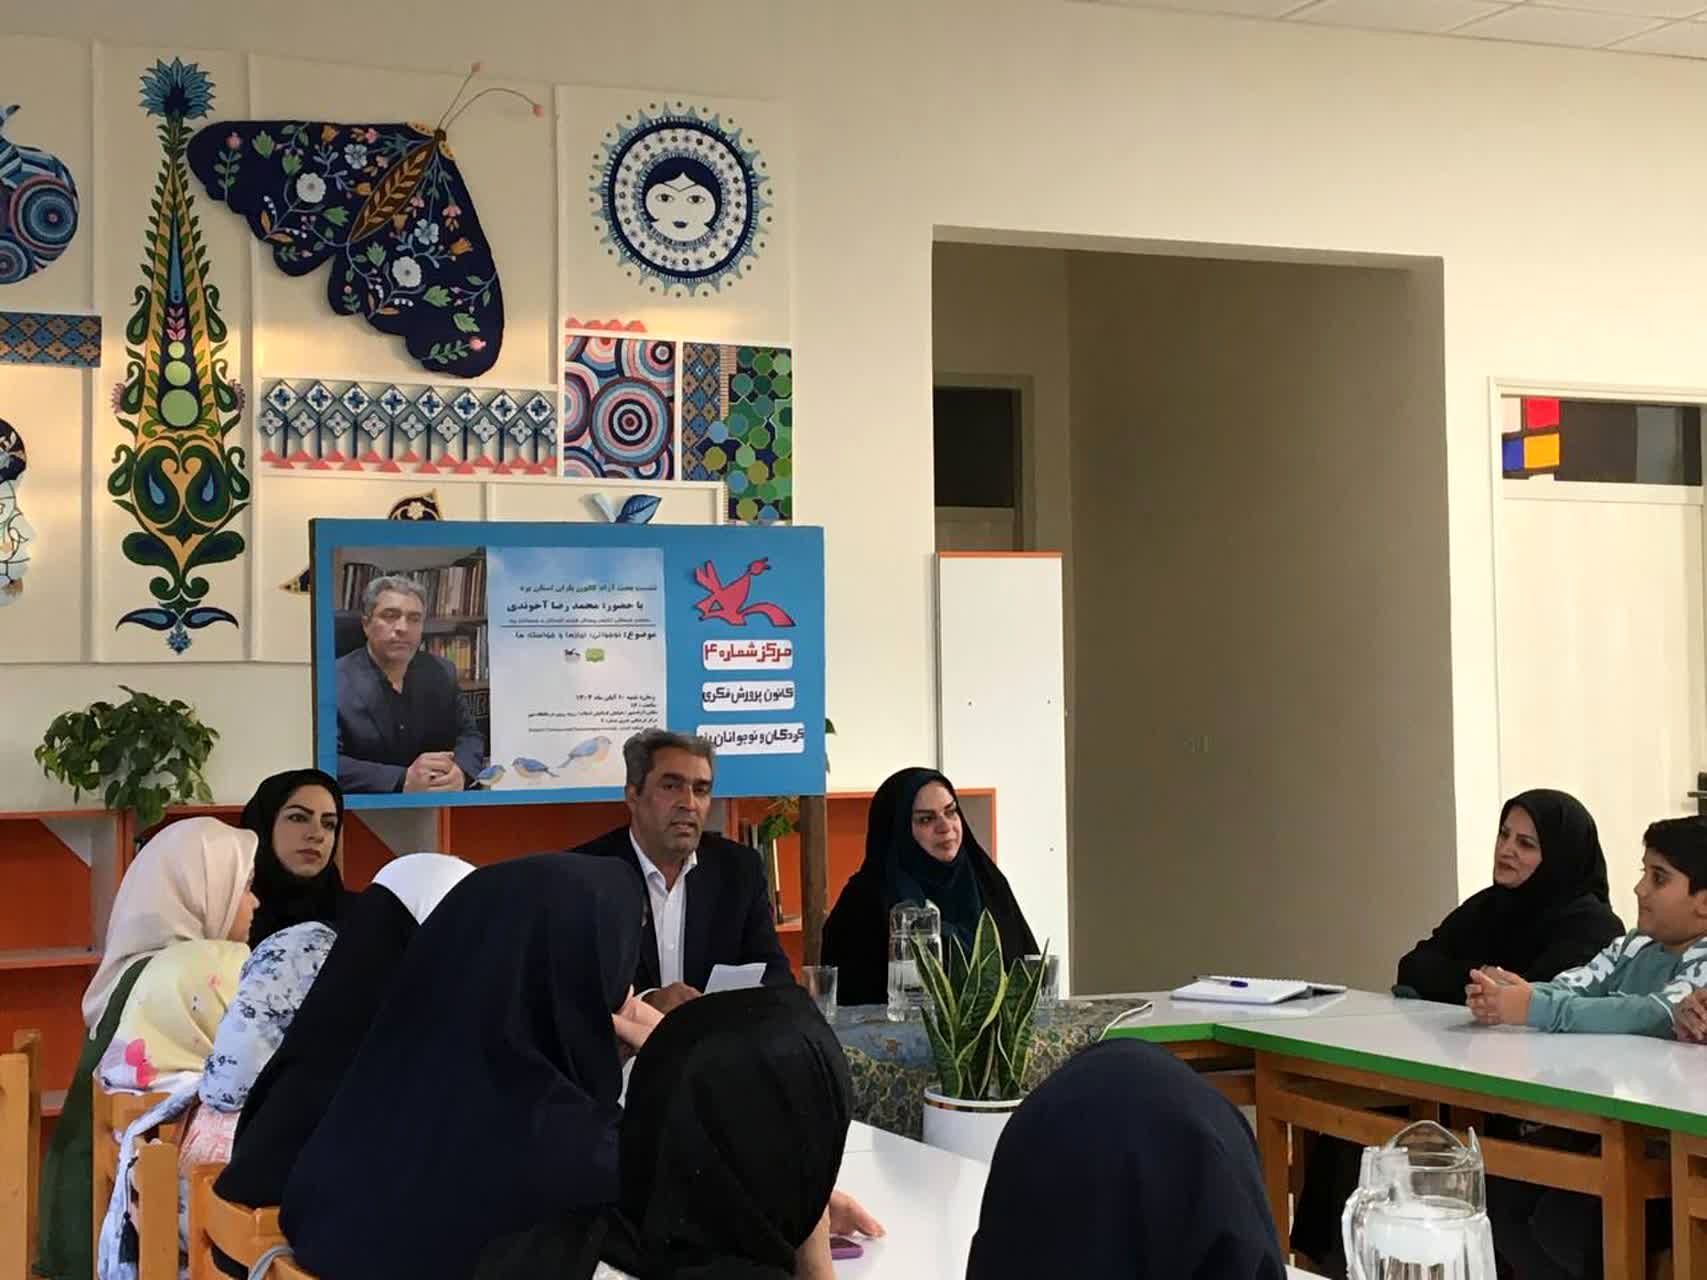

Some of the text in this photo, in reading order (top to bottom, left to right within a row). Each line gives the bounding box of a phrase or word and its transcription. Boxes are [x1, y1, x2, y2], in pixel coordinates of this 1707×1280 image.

[551, 601, 569, 612] رضا
[571, 602, 599, 610] محمد
[704, 641, 792, 662] مرکز شماره ۴
[702, 687, 731, 703] فکری
[763, 687, 794, 702] کانون
[713, 731, 758, 747] نوجوانان
